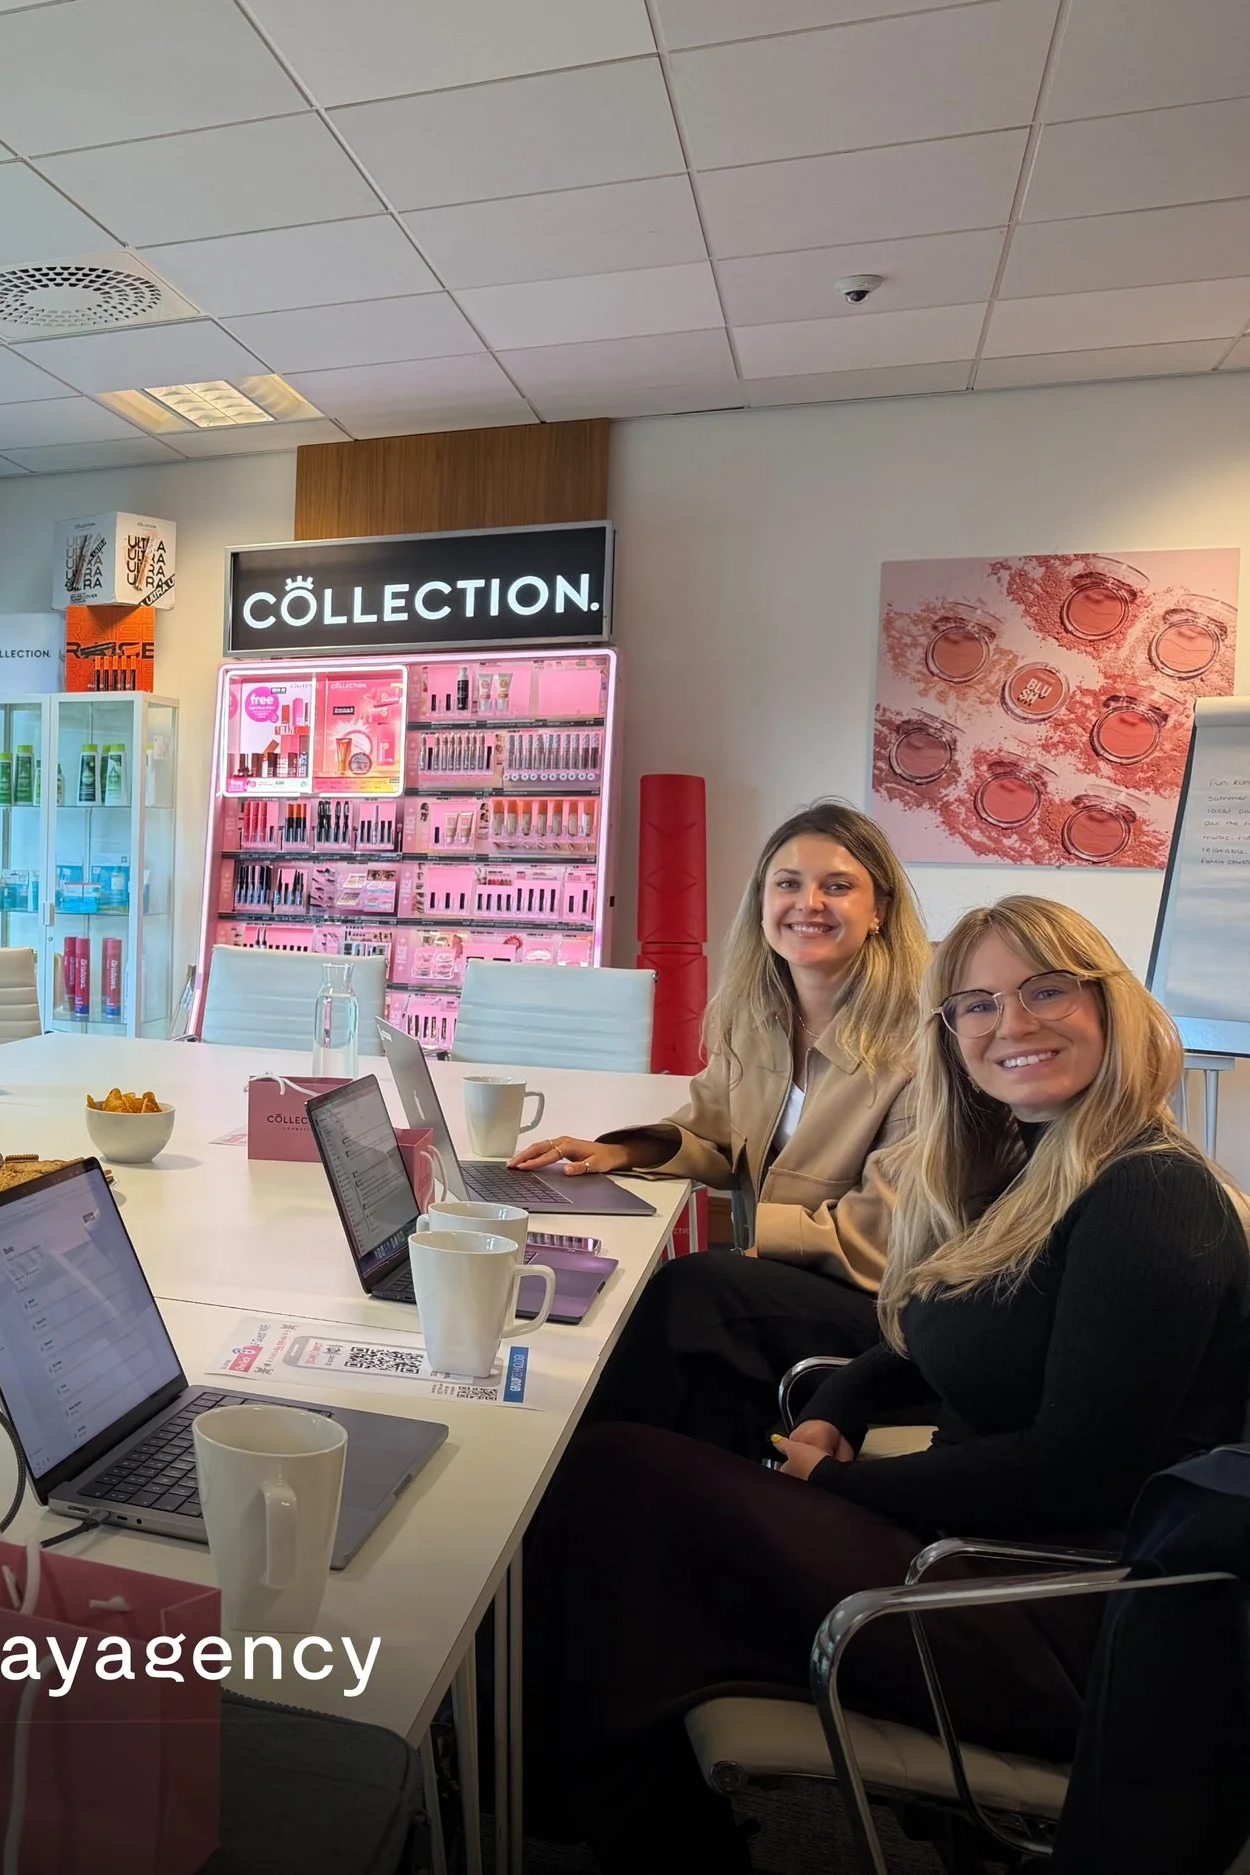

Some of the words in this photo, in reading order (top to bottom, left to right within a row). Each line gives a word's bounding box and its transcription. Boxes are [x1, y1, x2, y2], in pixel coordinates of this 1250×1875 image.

[128, 535, 166, 553] ULTA
[250, 693, 275, 705] free
[267, 1114, 308, 1125] COLLEC
